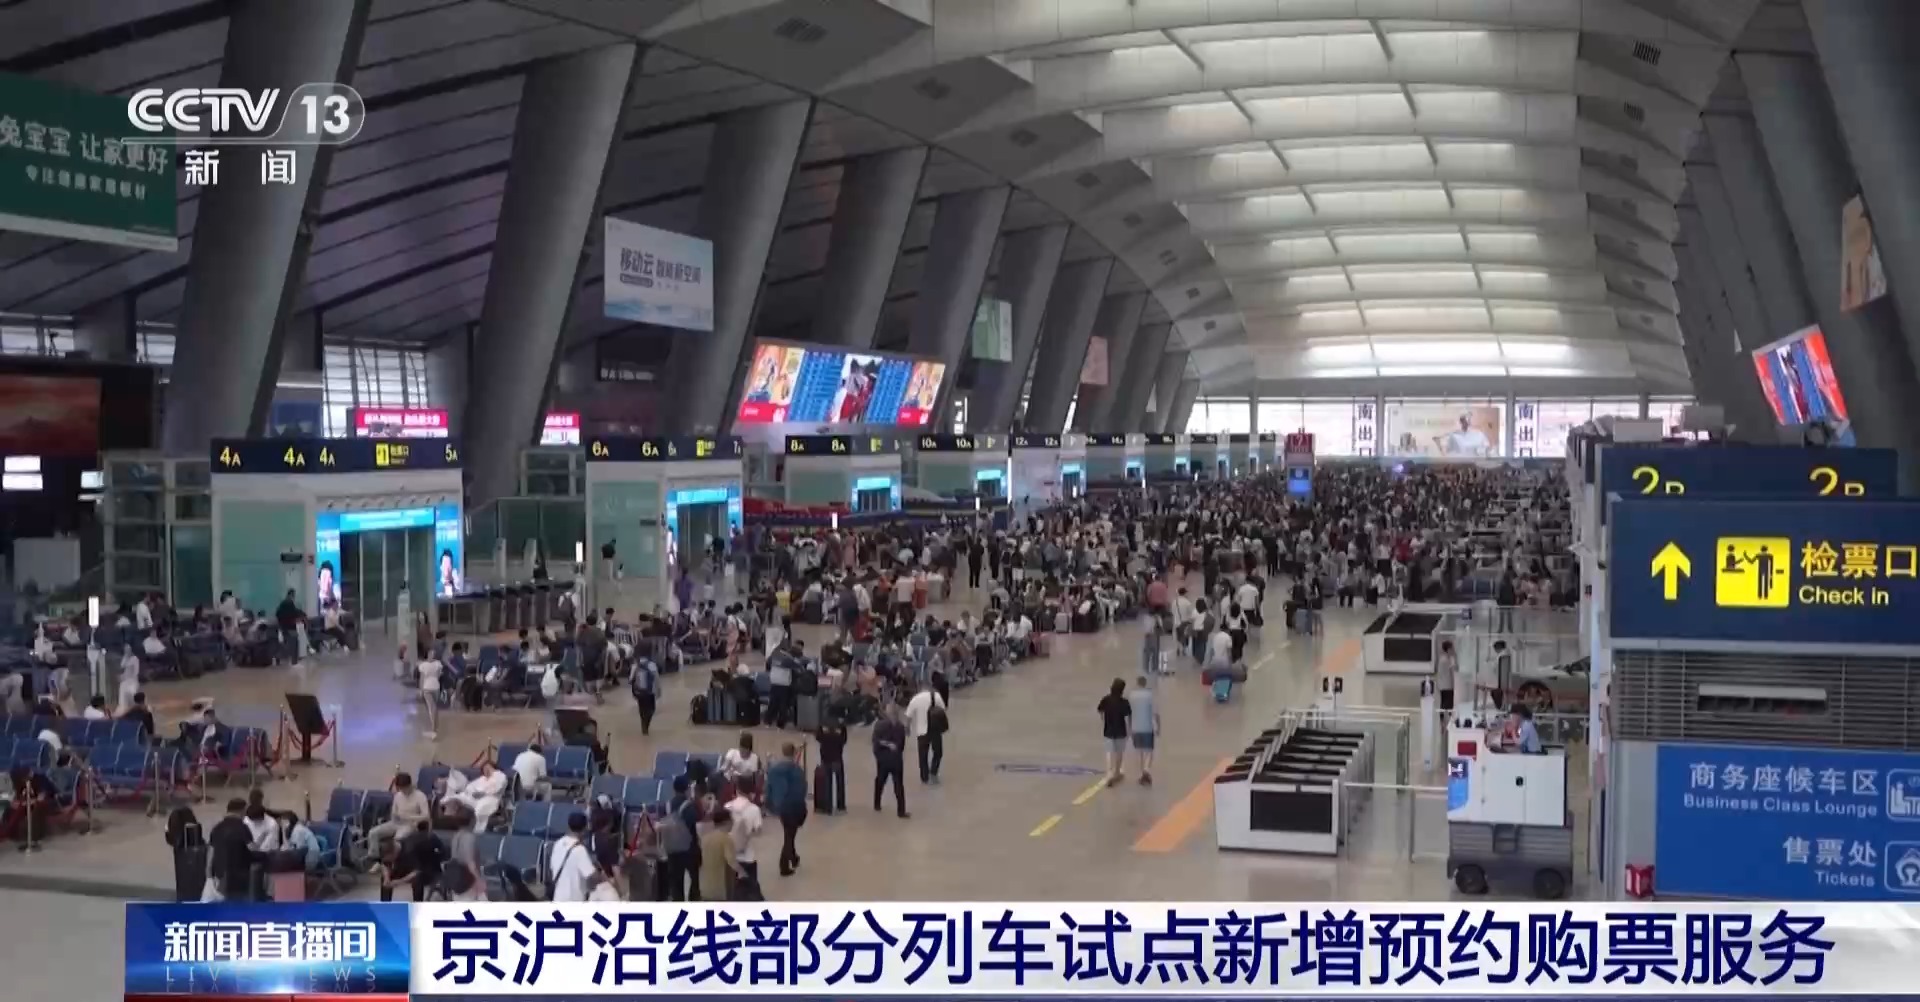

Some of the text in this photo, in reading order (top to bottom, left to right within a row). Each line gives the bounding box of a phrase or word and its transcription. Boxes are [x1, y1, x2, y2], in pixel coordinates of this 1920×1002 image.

[619, 247, 654, 276] 移动云
[592, 440, 660, 457] 6A 6A
[789, 437, 846, 452] 8A 8A
[955, 437, 972, 449] 10A
[1015, 436, 1058, 446] 12A 12A
[219, 445, 306, 467] 4A 4A
[319, 445, 336, 467] 4A
[445, 443, 459, 463] 5A
[1800, 540, 1918, 579] 检票口
[1799, 585, 1864, 605] Check
[1688, 760, 1880, 796] 商务座候车区
[1683, 793, 1877, 818] Business Class Lounge
[1782, 836, 1877, 868] 售票处
[1814, 870, 1876, 888] Tickets
